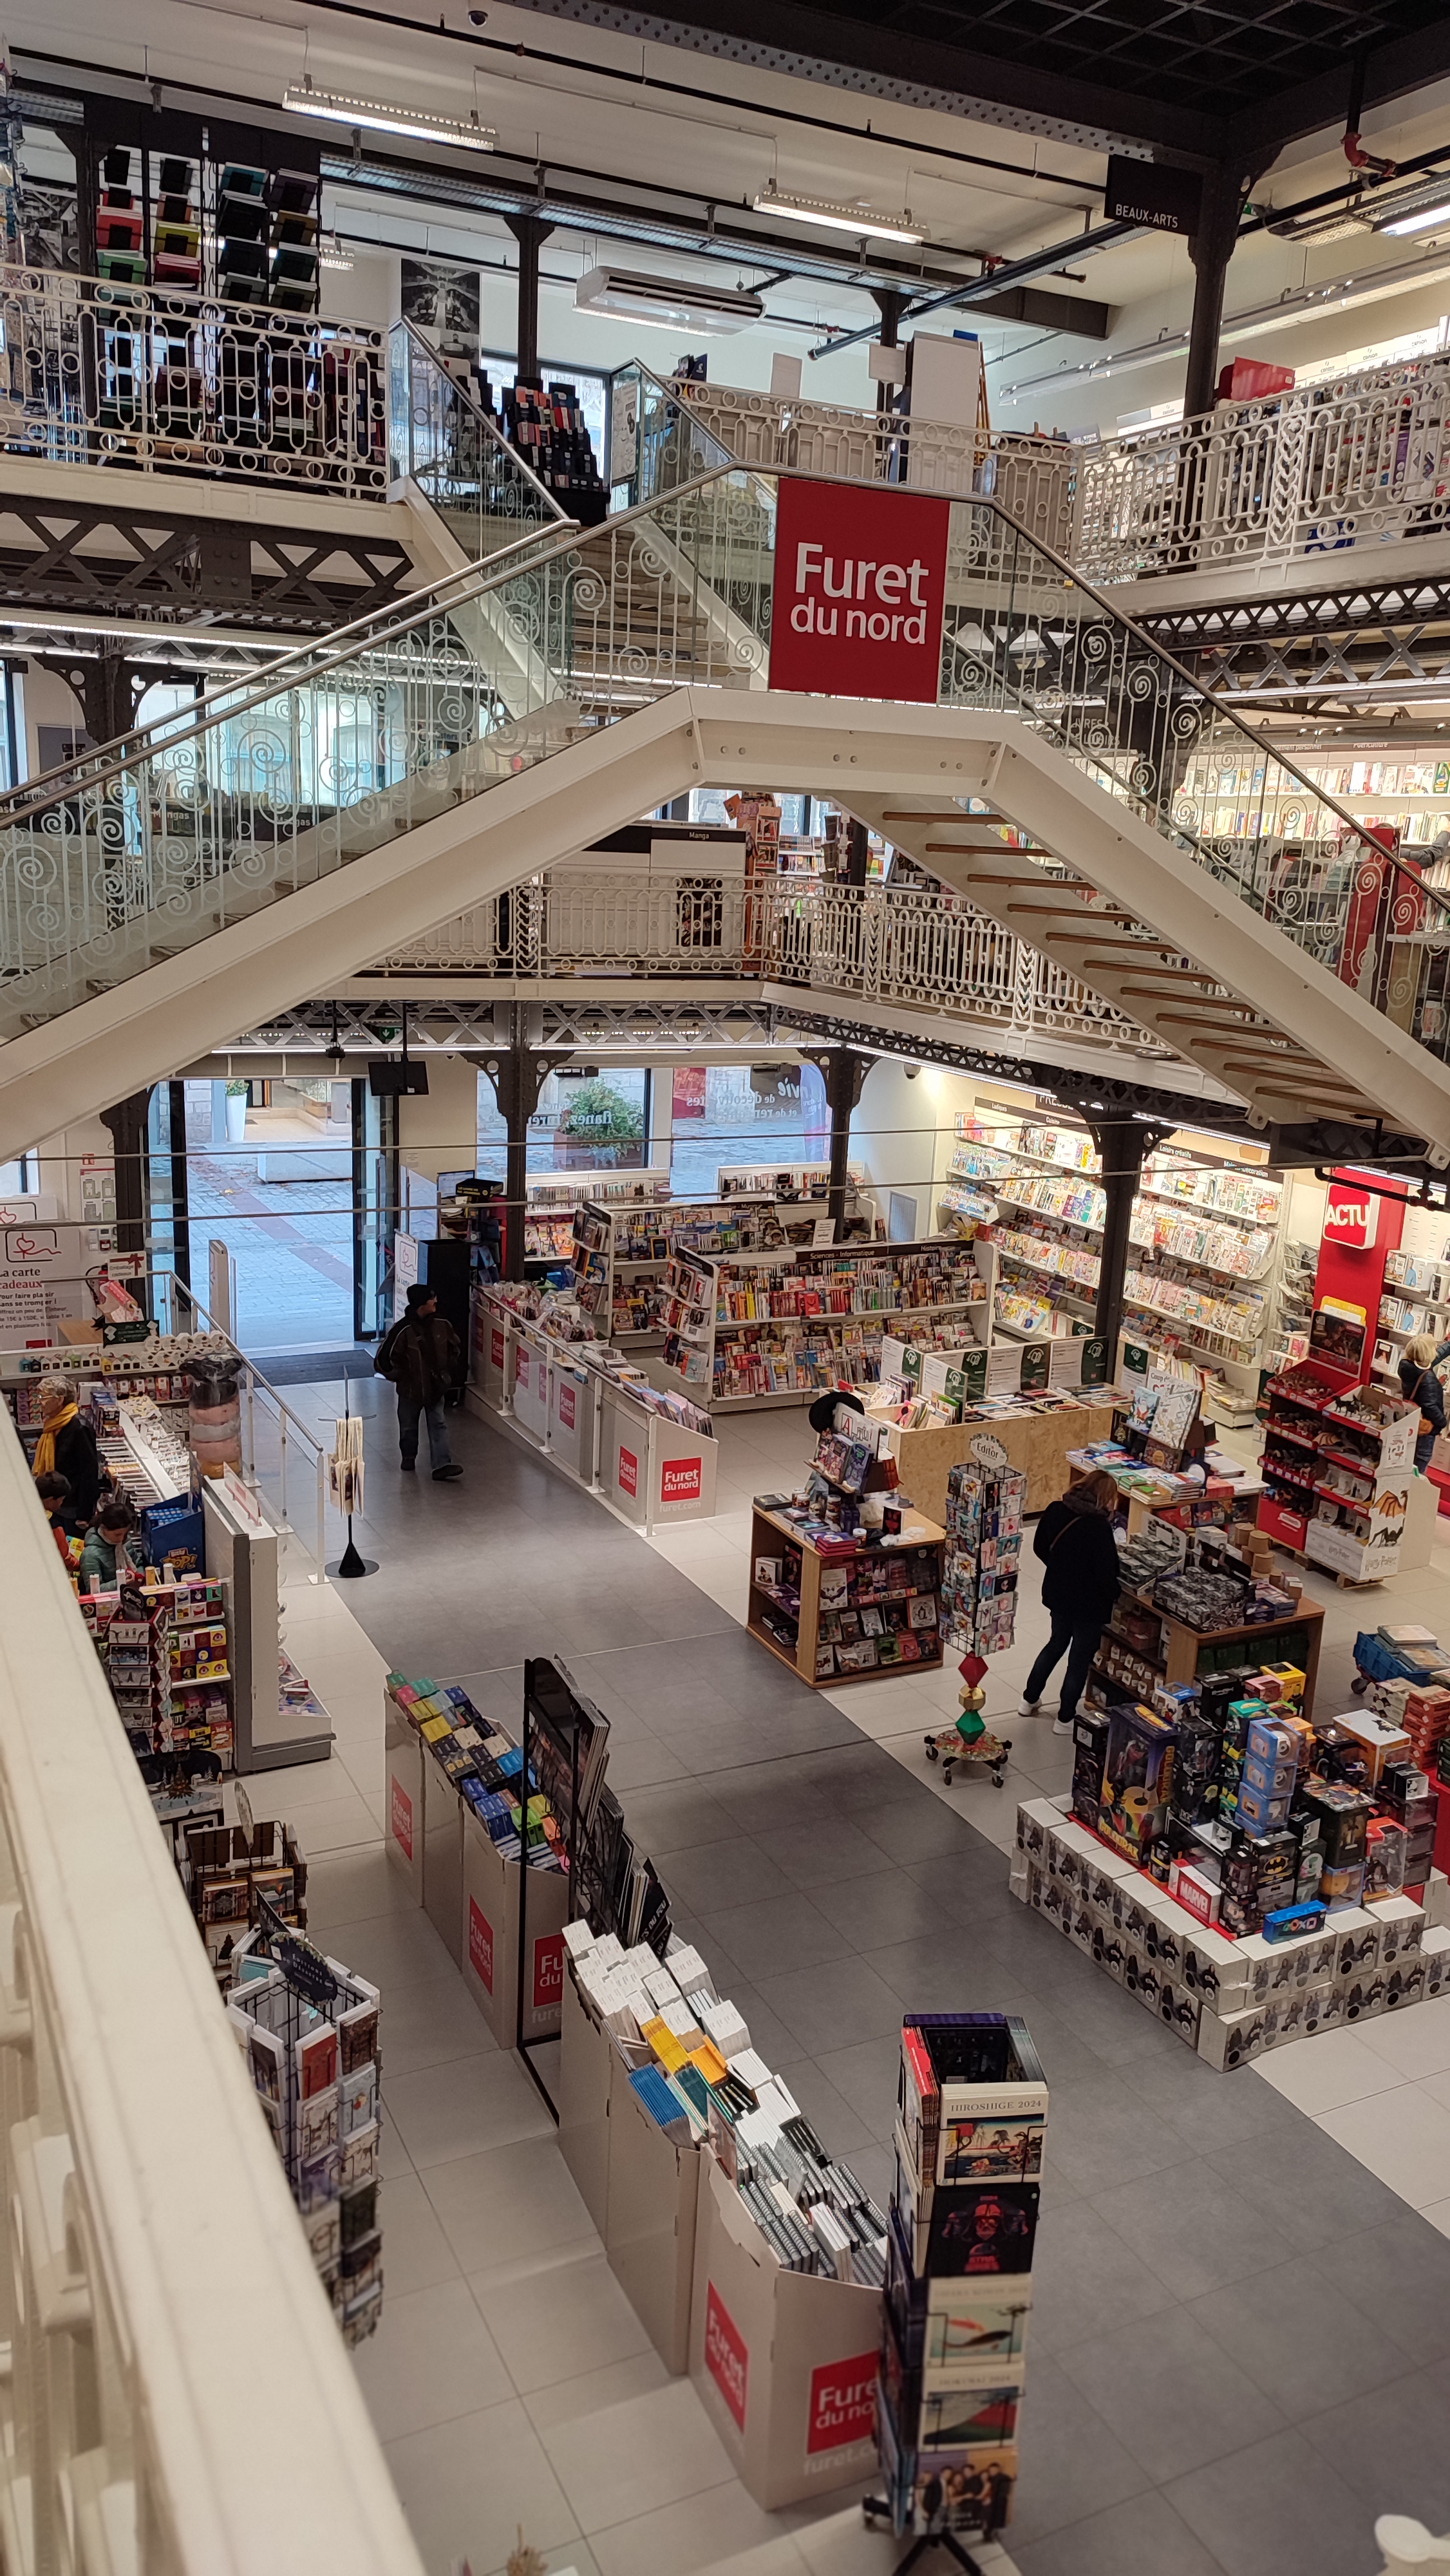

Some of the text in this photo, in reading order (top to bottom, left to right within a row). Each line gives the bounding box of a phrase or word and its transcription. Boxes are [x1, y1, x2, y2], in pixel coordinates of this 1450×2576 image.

[1115, 204, 1178, 228] BEAUX-ARTS
[795, 542, 929, 607] Furet
[790, 596, 927, 645] du nord
[153, 805, 190, 821] Mngas
[276, 815, 310, 828] Magas
[689, 831, 710, 840] Manga
[1039, 1095, 1074, 1111] PRE
[1160, 1144, 1174, 1154] Loisirs
[1325, 1204, 1370, 1227] ACTU
[810, 1252, 834, 1260] Sciences
[840, 1249, 875, 1258] Informatique
[12, 1268, 41, 1277] carte
[1151, 1372, 1163, 1383] Coup
[621, 1457, 636, 1478] Furet
[665, 1468, 699, 1483] Furet
[664, 1477, 699, 1492] du nord
[659, 1501, 701, 1513] furet.com
[1180, 1880, 1209, 1915] MARVEL
[471, 1913, 491, 1958] Furet
[540, 1973, 561, 1987] du
[951, 2099, 1042, 2112] HIROSHIGE 2024
[709, 2307, 744, 2385] Furet
[818, 2378, 878, 2412] Fure
[816, 2400, 876, 2430] du no
[805, 2444, 878, 2476] furet.c
